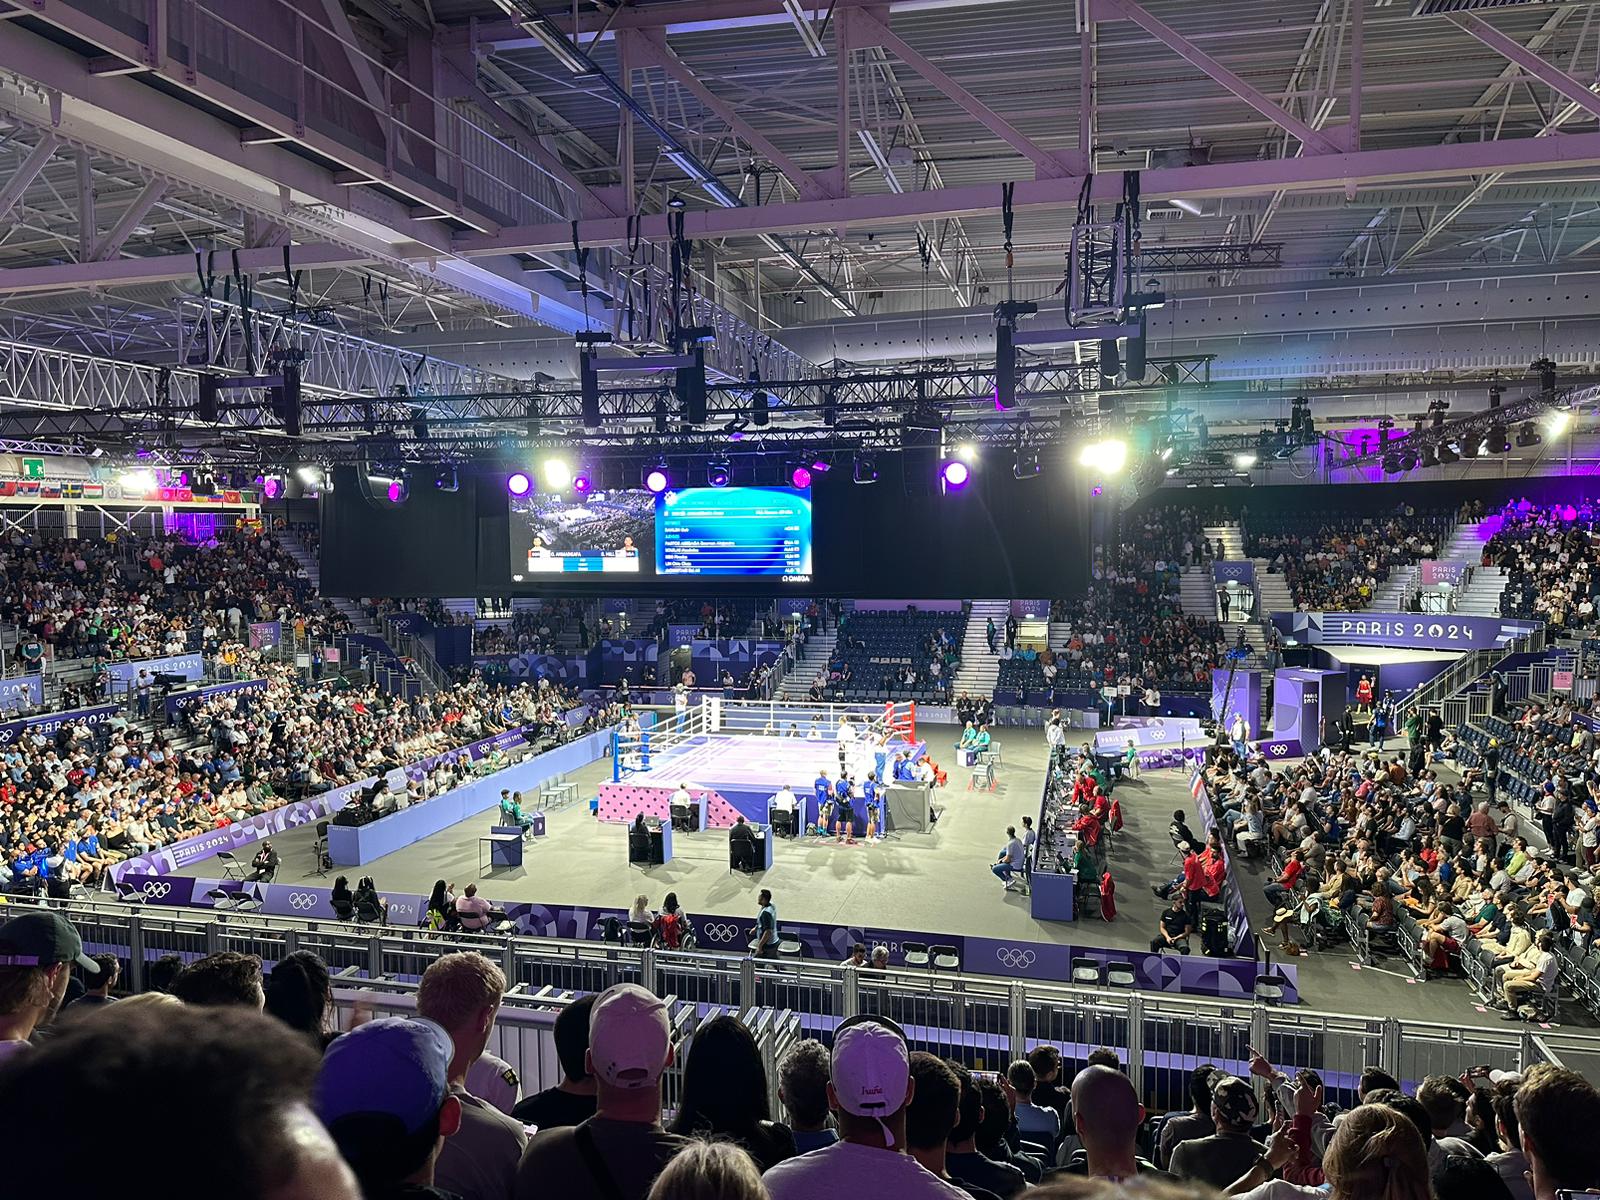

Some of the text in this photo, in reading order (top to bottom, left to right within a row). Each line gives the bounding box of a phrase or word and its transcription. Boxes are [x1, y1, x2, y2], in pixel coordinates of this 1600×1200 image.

[1413, 623, 1473, 641] 2024
[174, 660, 198, 671] 2024
[179, 835, 229, 858] PARIS 2024
[390, 903, 414, 915] 024
